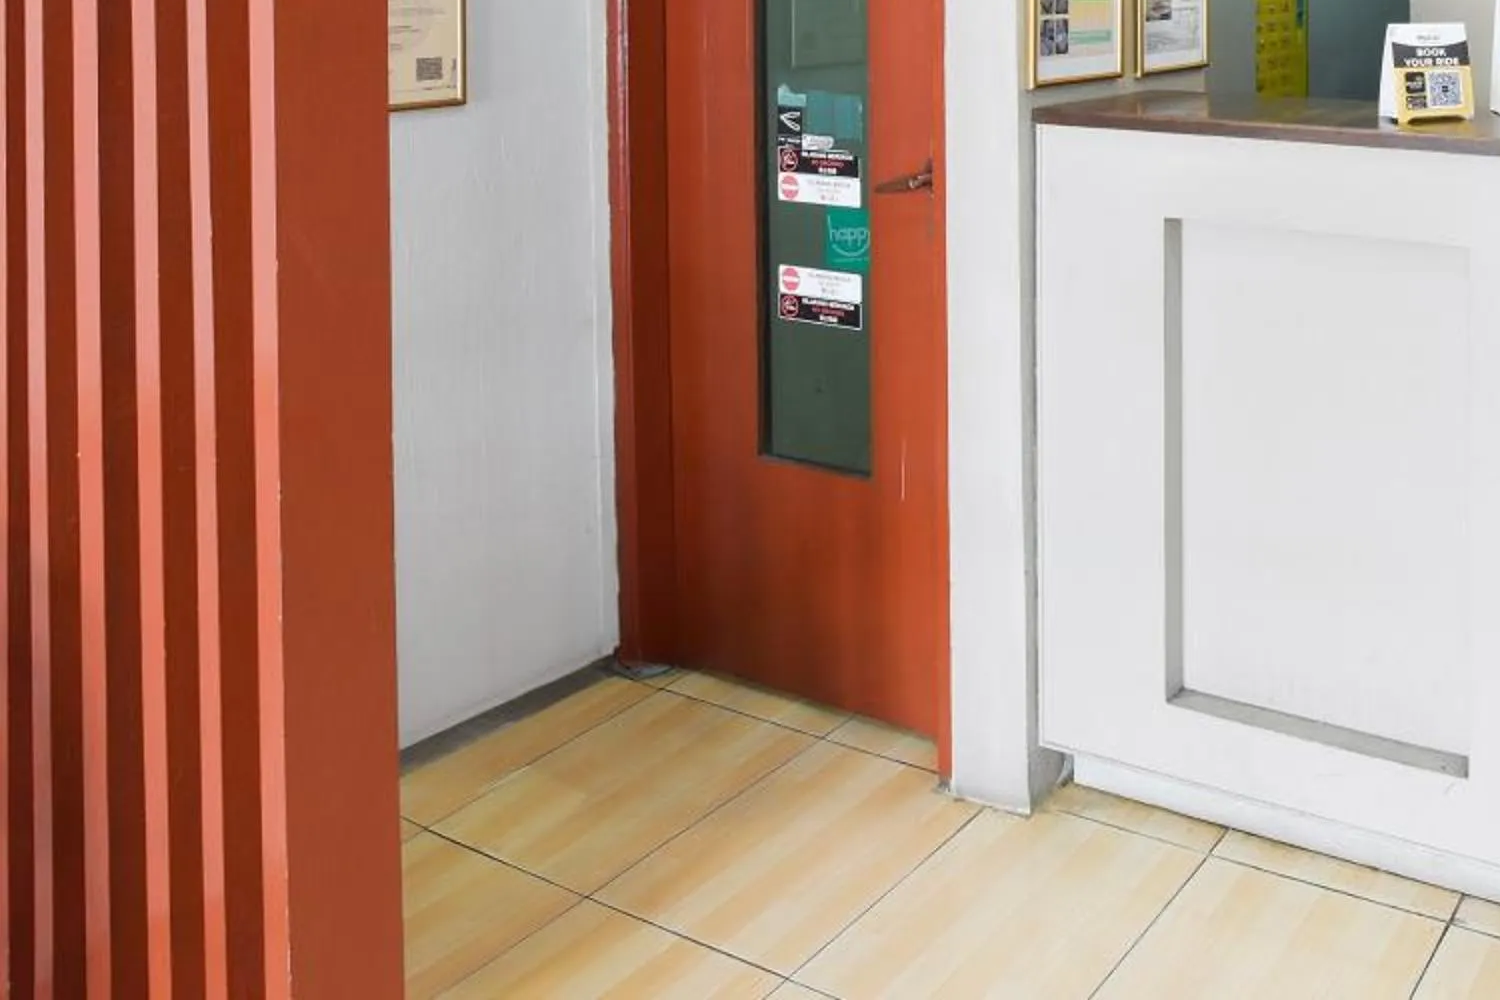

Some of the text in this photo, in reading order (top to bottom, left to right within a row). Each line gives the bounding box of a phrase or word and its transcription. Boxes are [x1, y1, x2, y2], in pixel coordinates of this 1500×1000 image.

[1415, 47, 1447, 57] BOOK
[1404, 57, 1459, 67] YOUR RIDE
